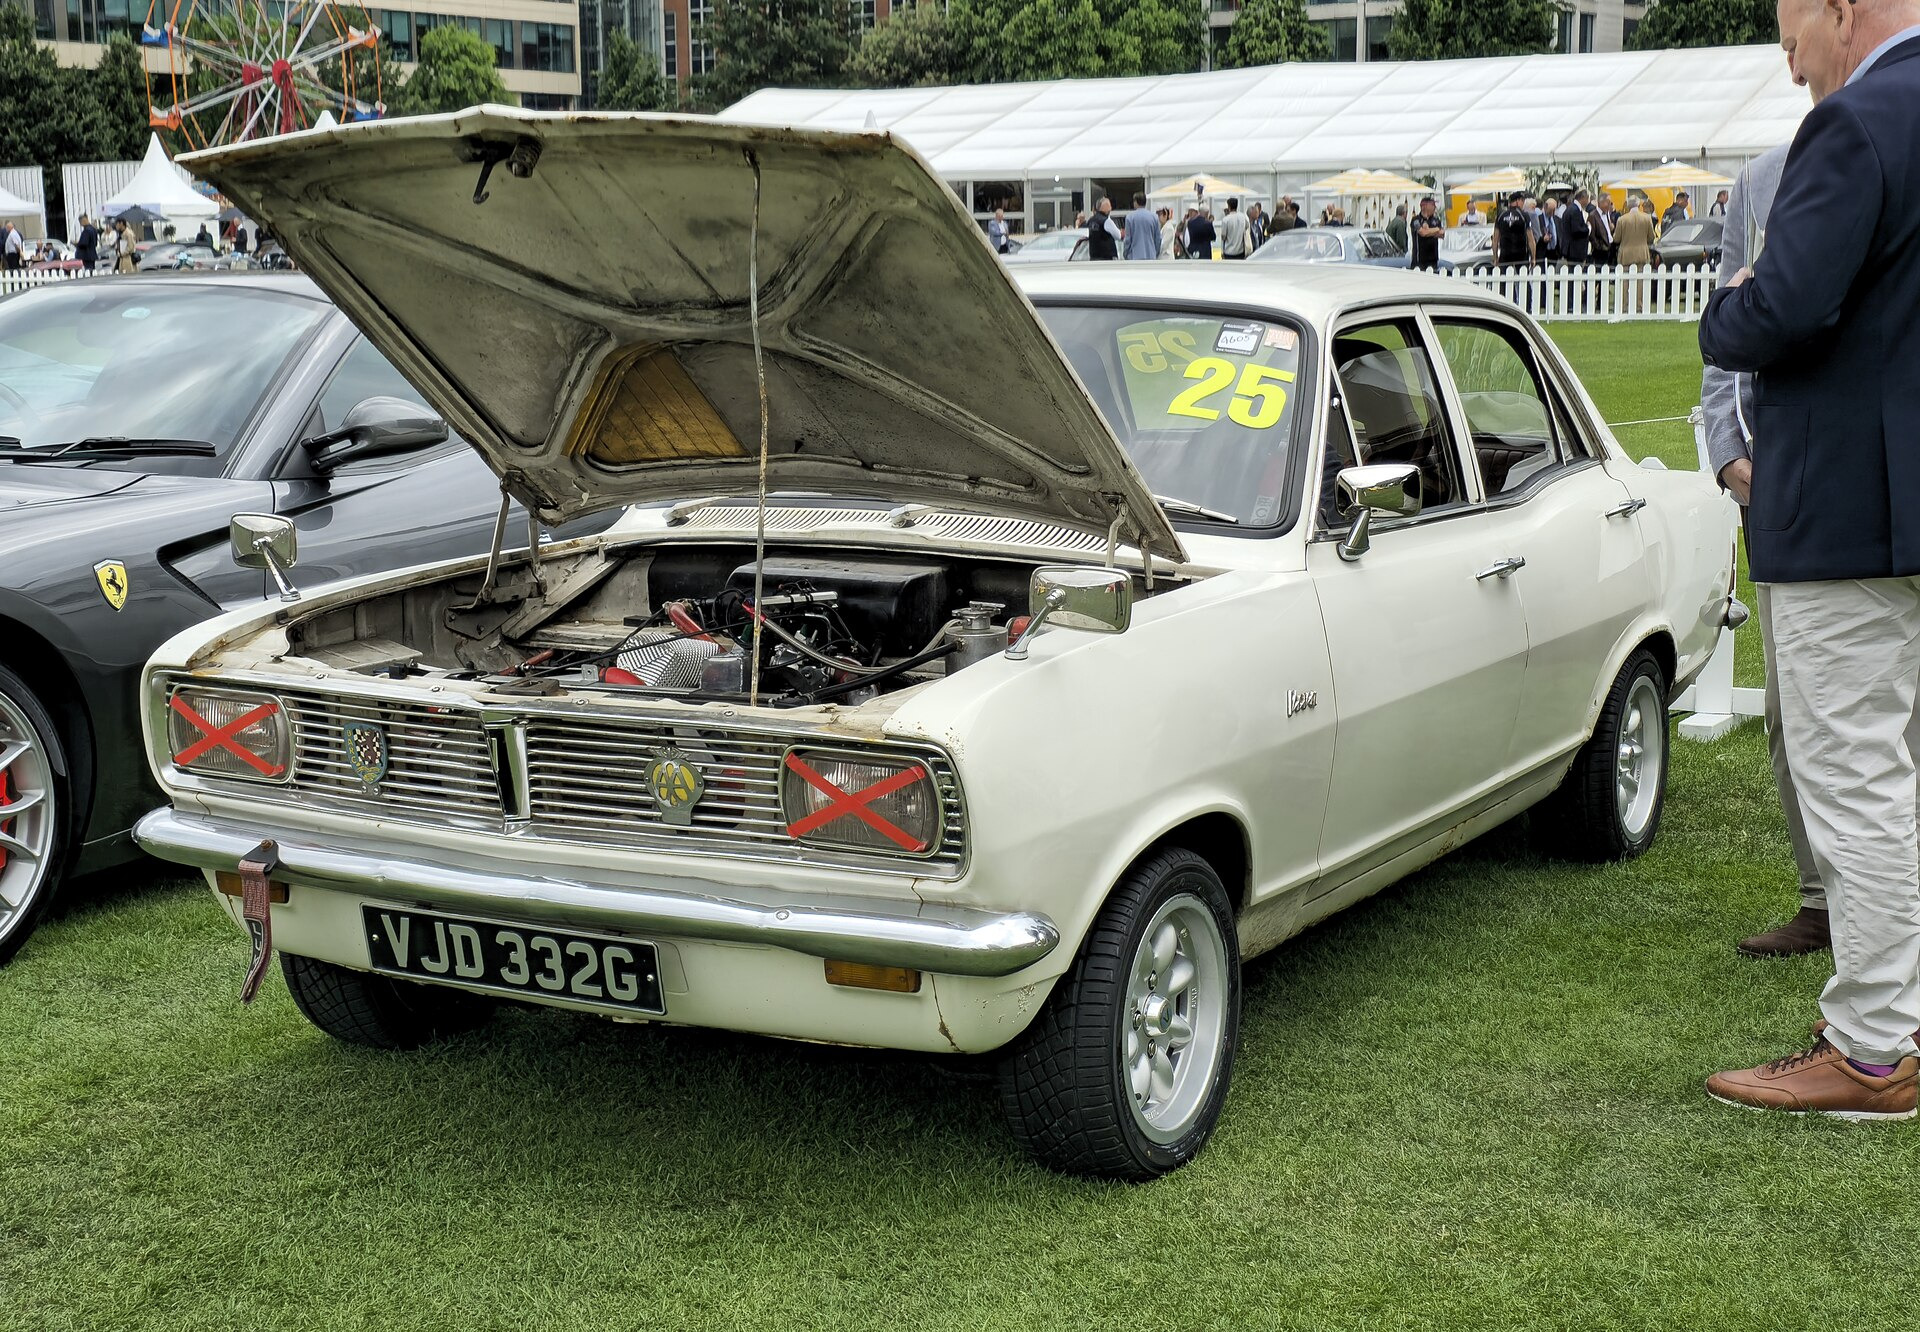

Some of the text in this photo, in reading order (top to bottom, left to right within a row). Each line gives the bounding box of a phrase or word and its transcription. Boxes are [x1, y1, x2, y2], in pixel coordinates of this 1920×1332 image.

[1166, 357, 1296, 430] 25
[380, 913, 638, 1001] VJD 332G
